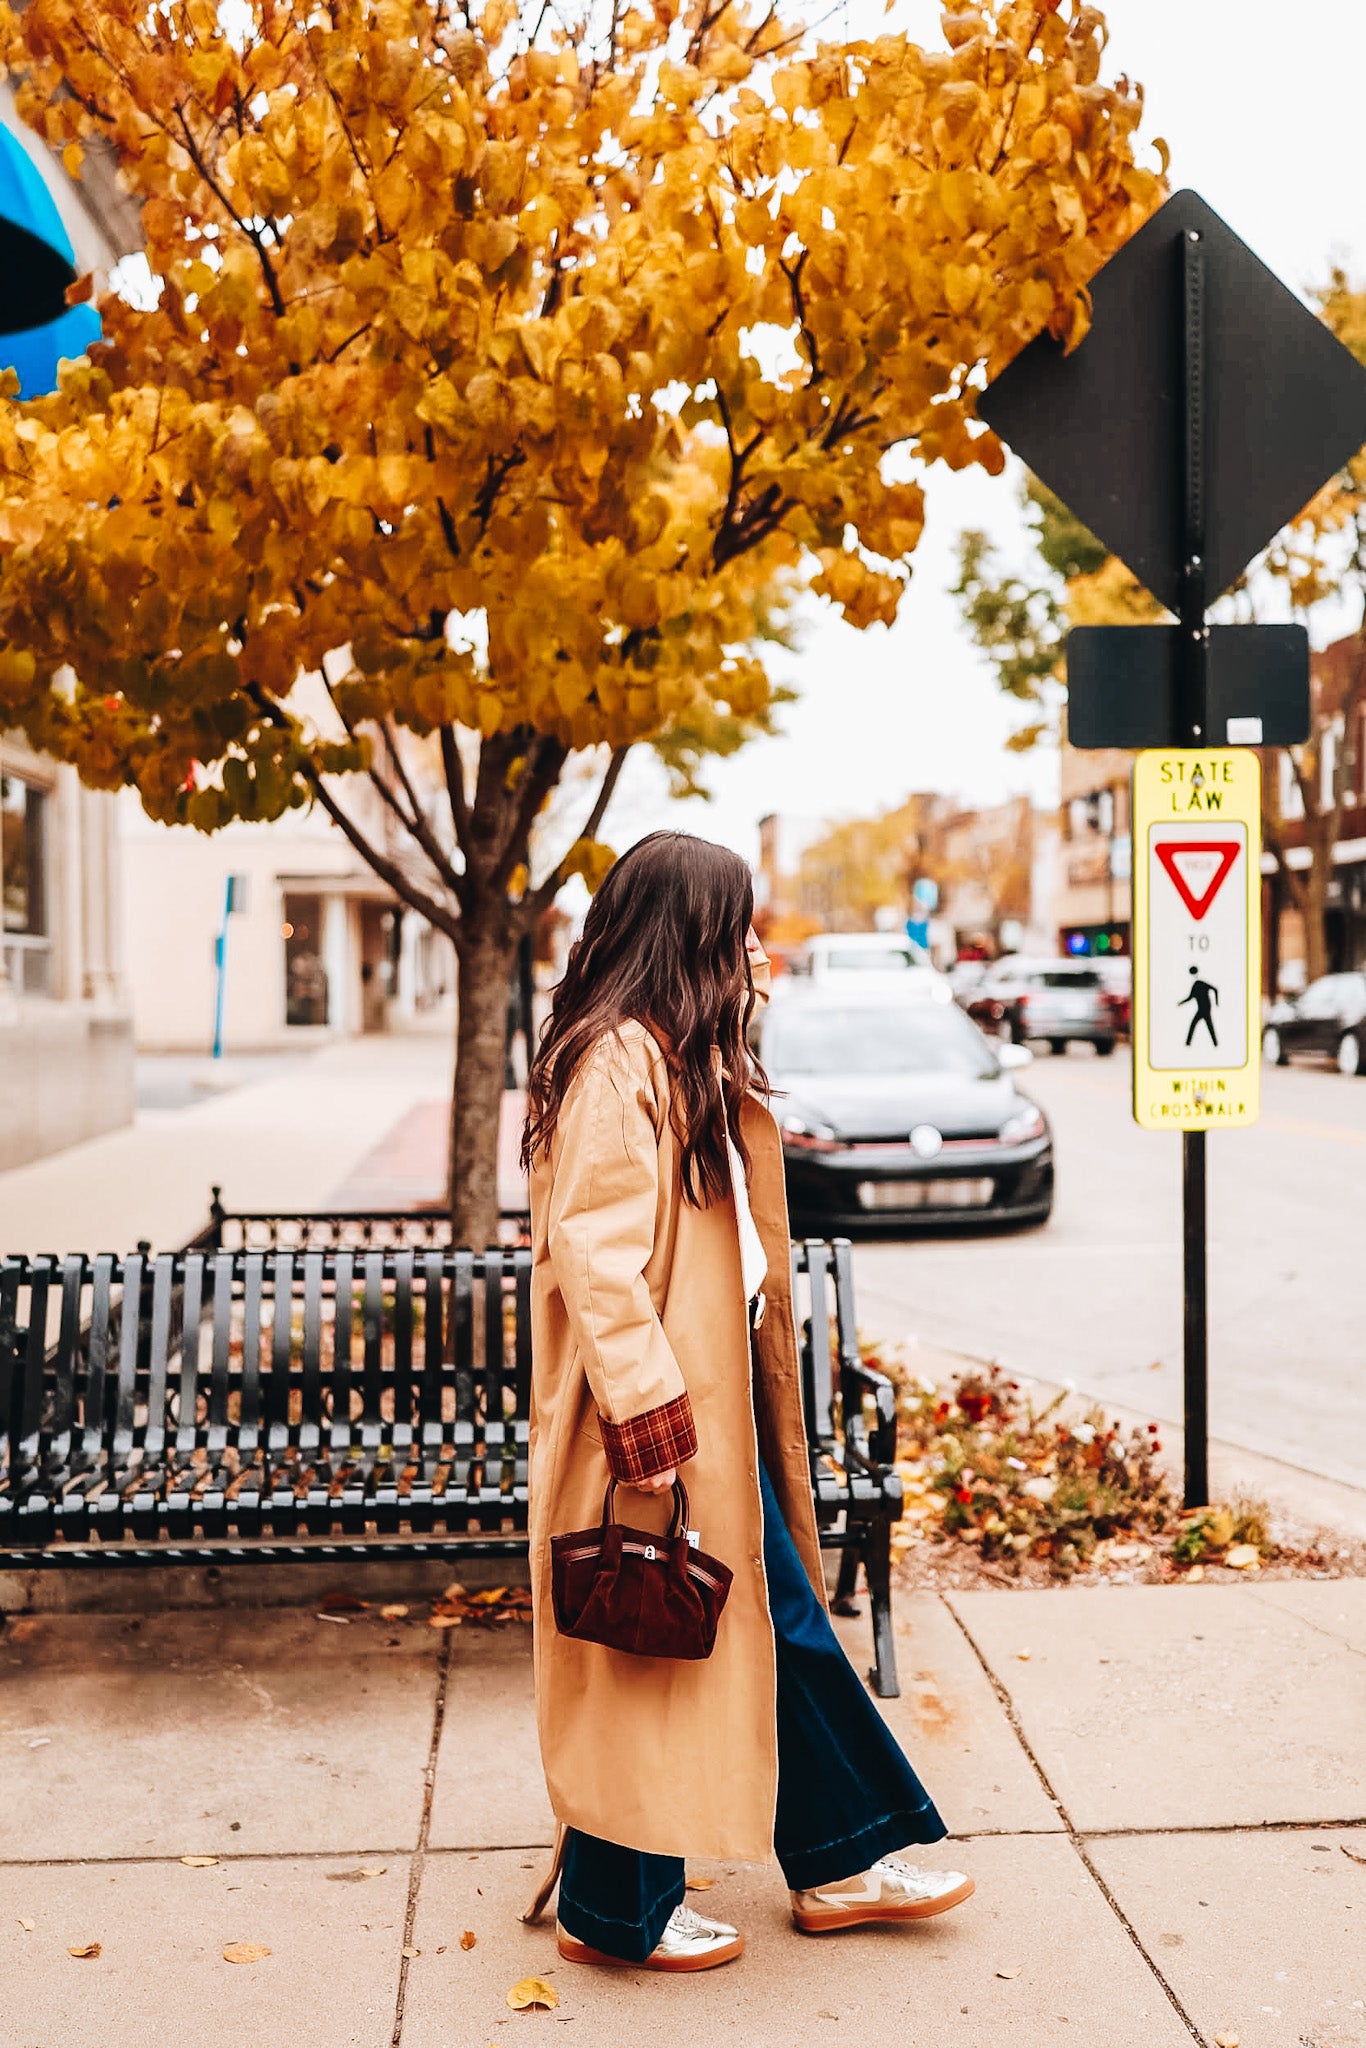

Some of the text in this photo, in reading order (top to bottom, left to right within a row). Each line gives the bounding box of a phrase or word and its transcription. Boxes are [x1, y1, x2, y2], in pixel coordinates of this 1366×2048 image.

[1160, 761, 1233, 783] STATE
[1172, 791, 1223, 812] LAW
[1187, 935, 1210, 950] TO
[1172, 1080, 1226, 1093] WITHIN
[1150, 1102, 1246, 1118] CROSSWALK
